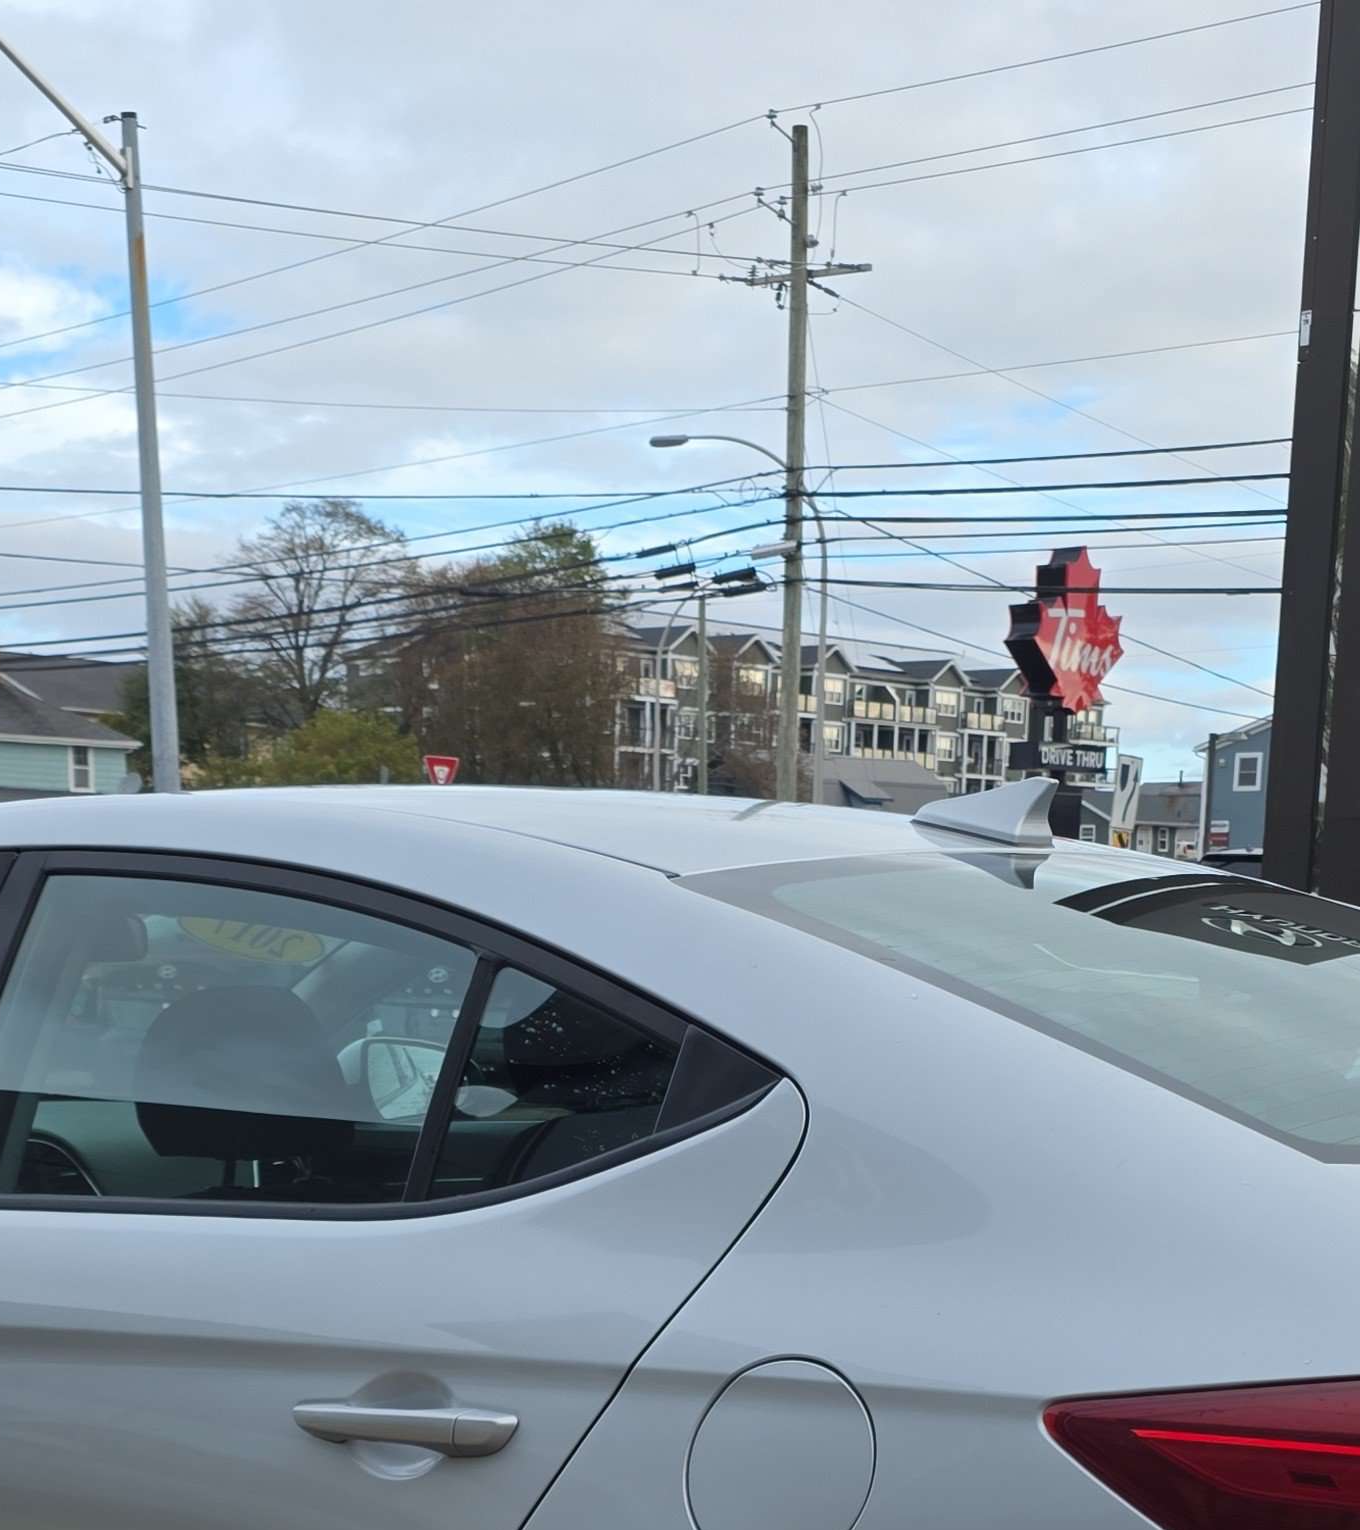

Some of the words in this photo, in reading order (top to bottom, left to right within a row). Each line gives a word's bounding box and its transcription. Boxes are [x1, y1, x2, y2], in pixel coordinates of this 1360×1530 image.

[1048, 608, 1114, 677] Tims
[1041, 748, 1073, 766] DRIVE
[1076, 750, 1104, 768] THRU
